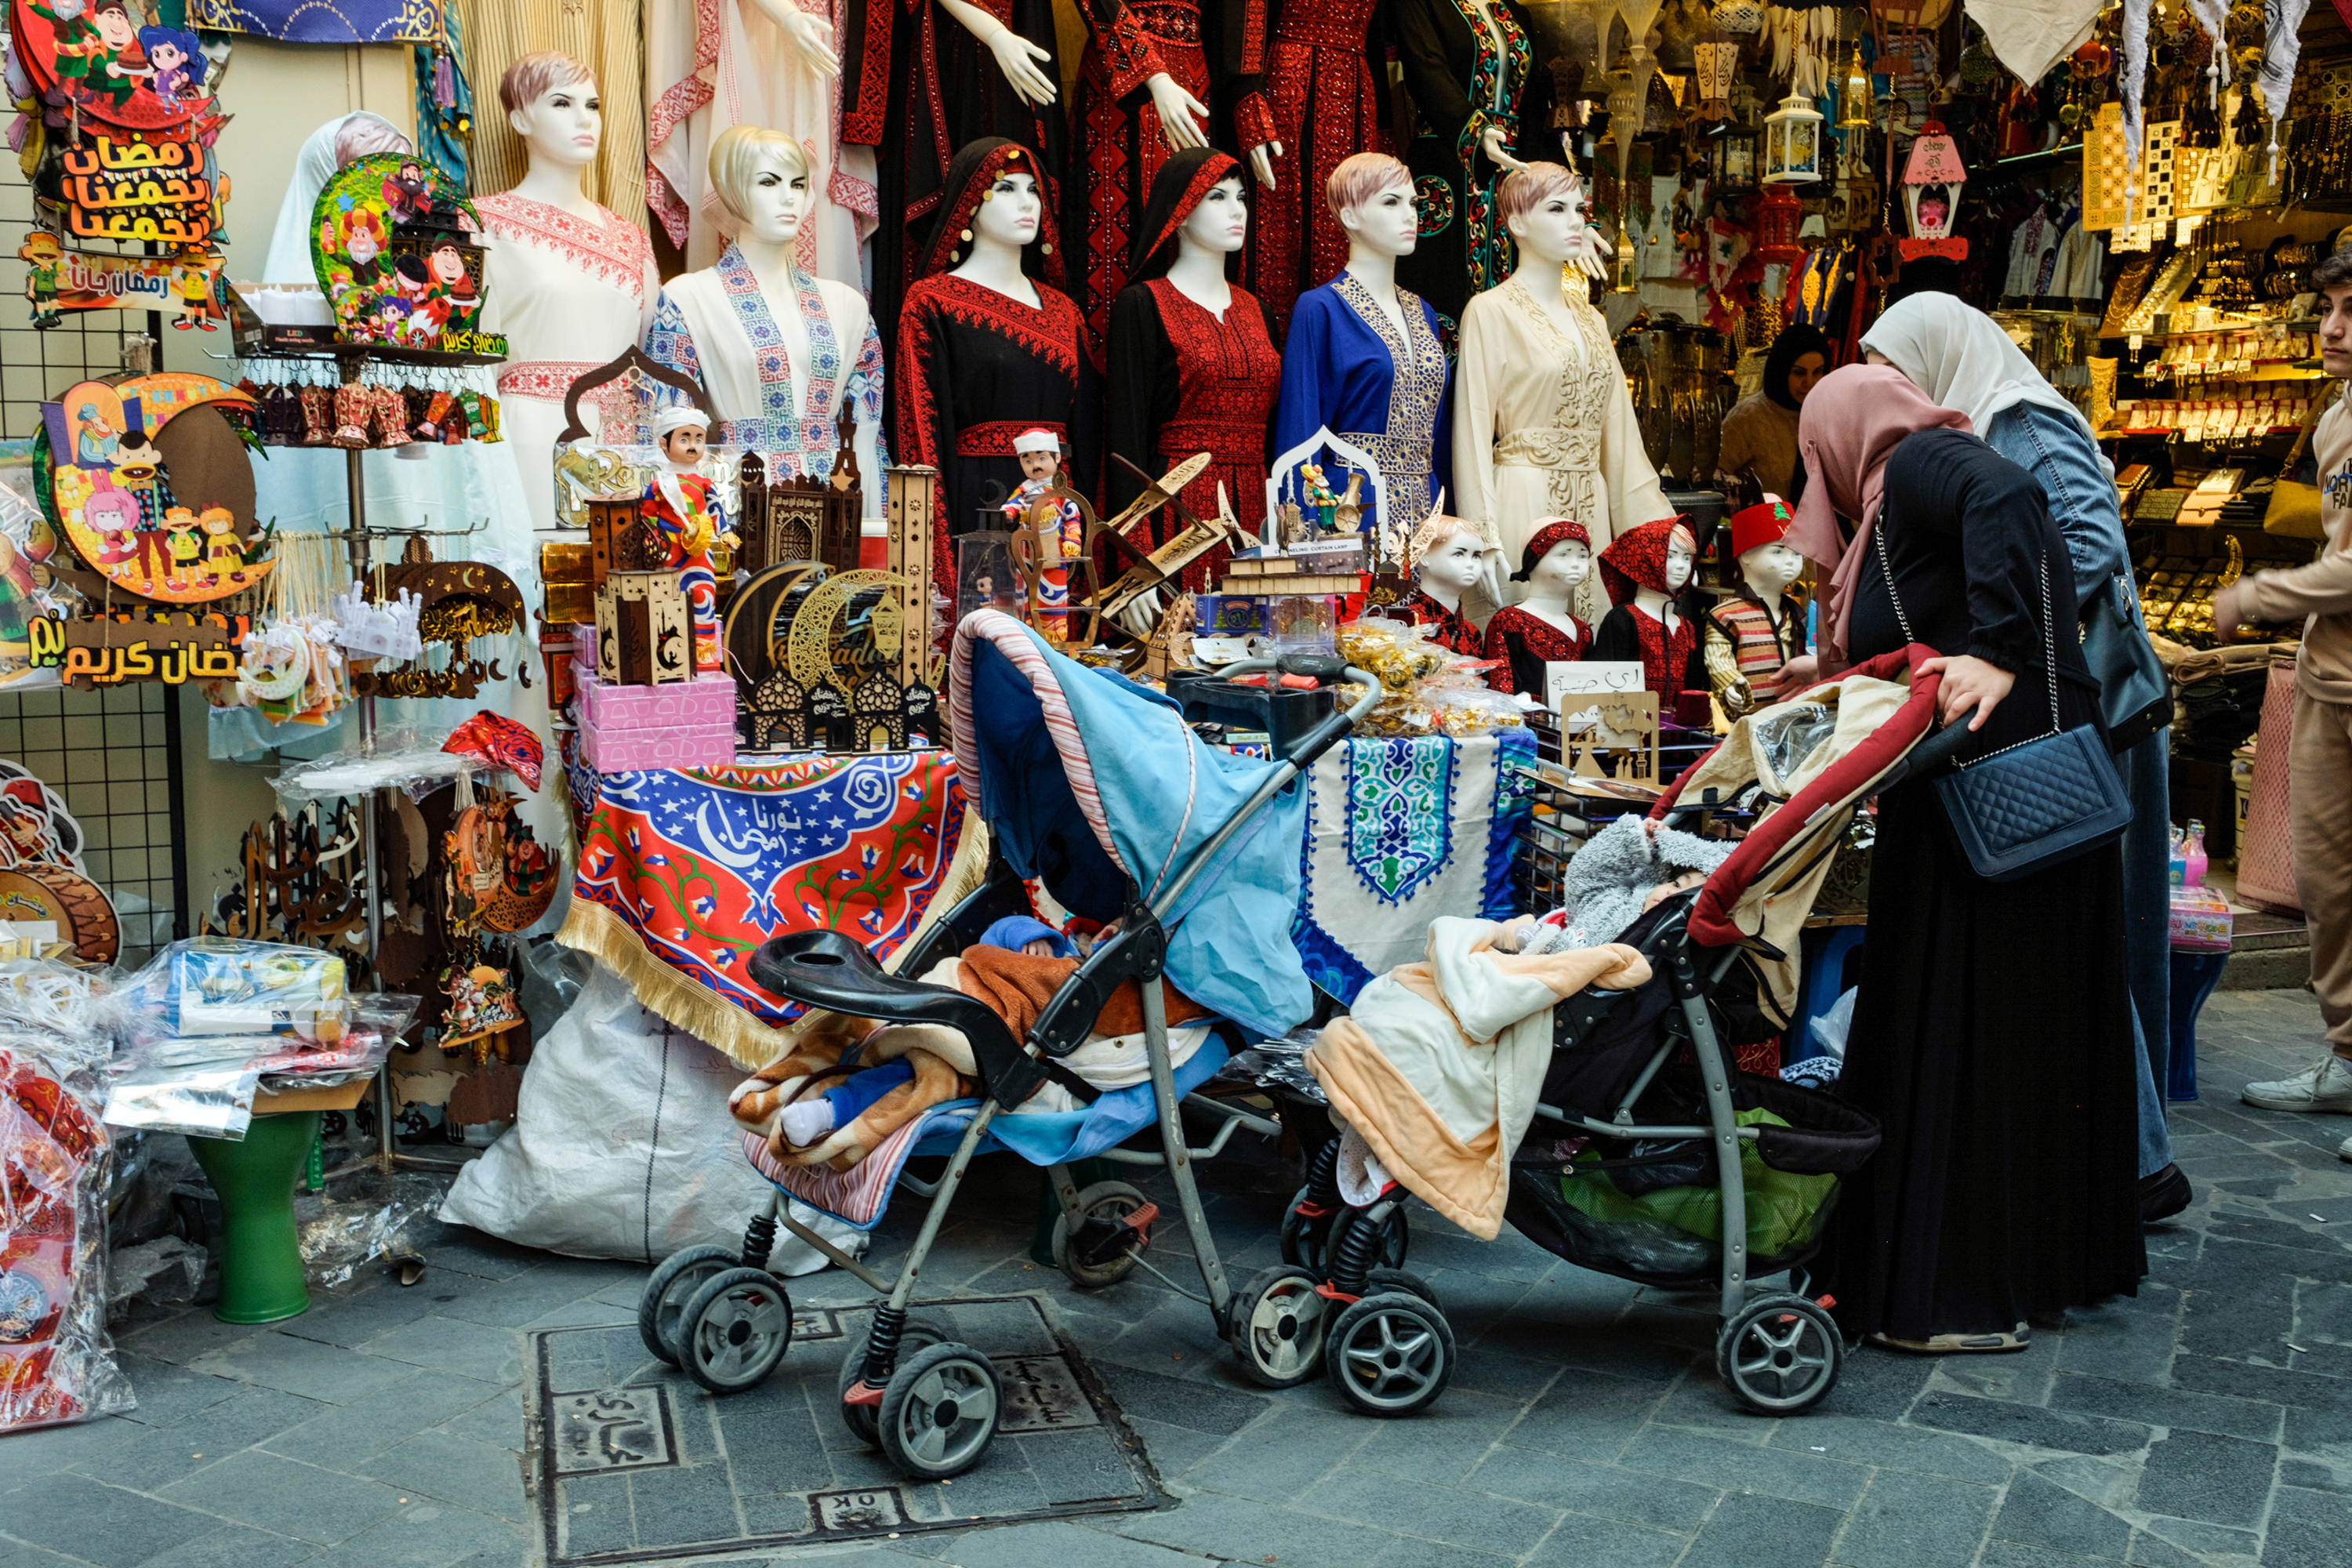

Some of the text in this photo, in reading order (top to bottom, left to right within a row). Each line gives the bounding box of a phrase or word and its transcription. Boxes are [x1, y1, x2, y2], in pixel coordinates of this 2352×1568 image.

[64, 132, 205, 175] رمضان
[75, 176, 209, 211] يجمعنا
[71, 265, 169, 299] رمضان جانا
[442, 330, 510, 357] رمضان كريم
[62, 640, 246, 685] ضان كريم
[811, 687, 837, 701] رمضان
[906, 688, 931, 701] رمضان
[908, 701, 931, 716] كريم
